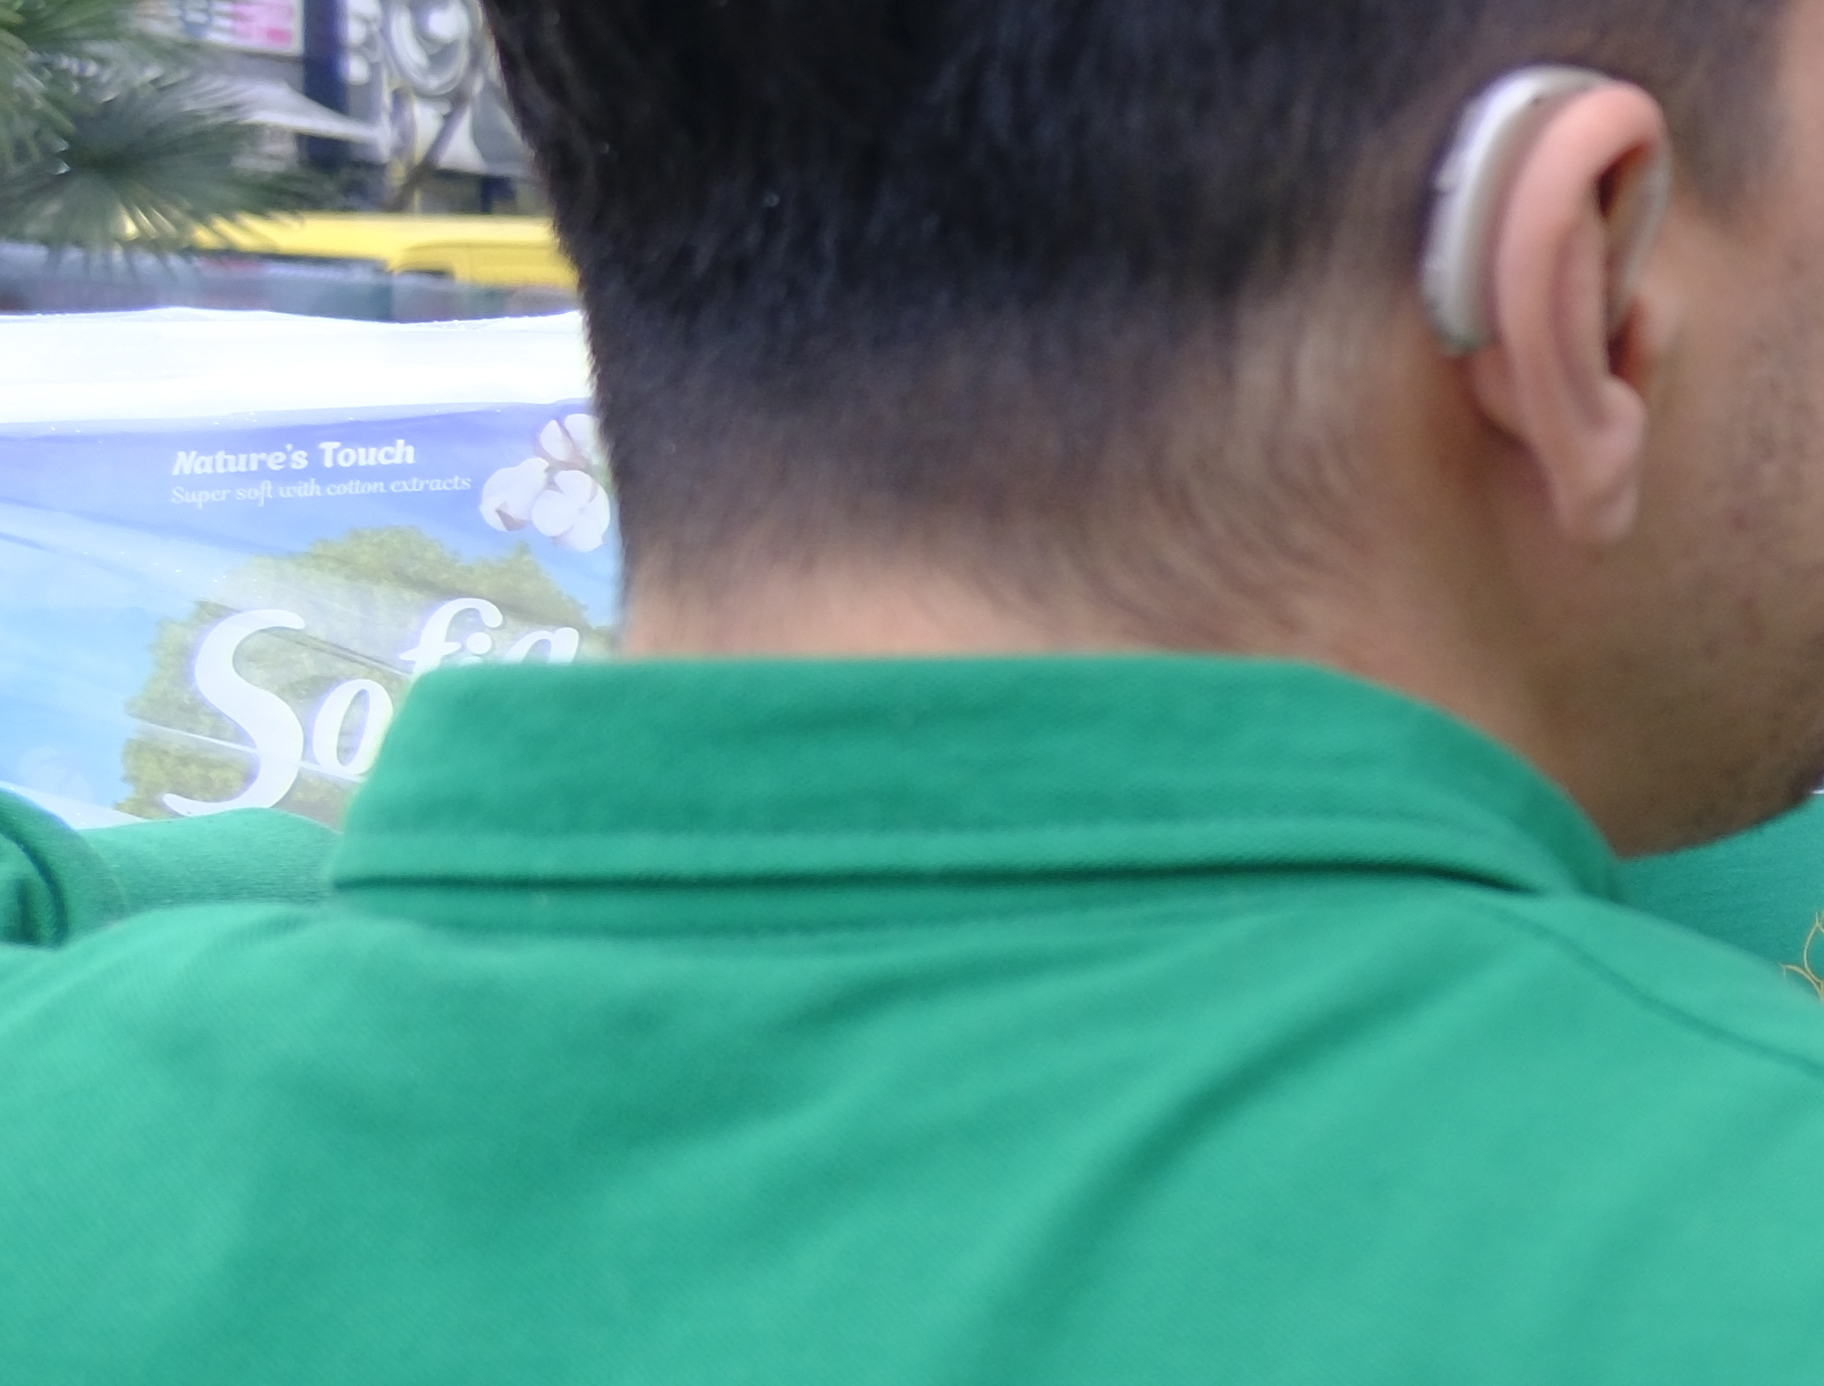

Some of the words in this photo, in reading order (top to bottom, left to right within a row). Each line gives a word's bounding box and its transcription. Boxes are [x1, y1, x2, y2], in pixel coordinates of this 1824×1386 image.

[172, 441, 308, 476] Nature's
[318, 438, 415, 469] Touch
[171, 485, 231, 510] Super
[236, 479, 273, 508] soft
[279, 477, 321, 498] with
[326, 476, 385, 497] cotton
[390, 474, 472, 495] extracts
